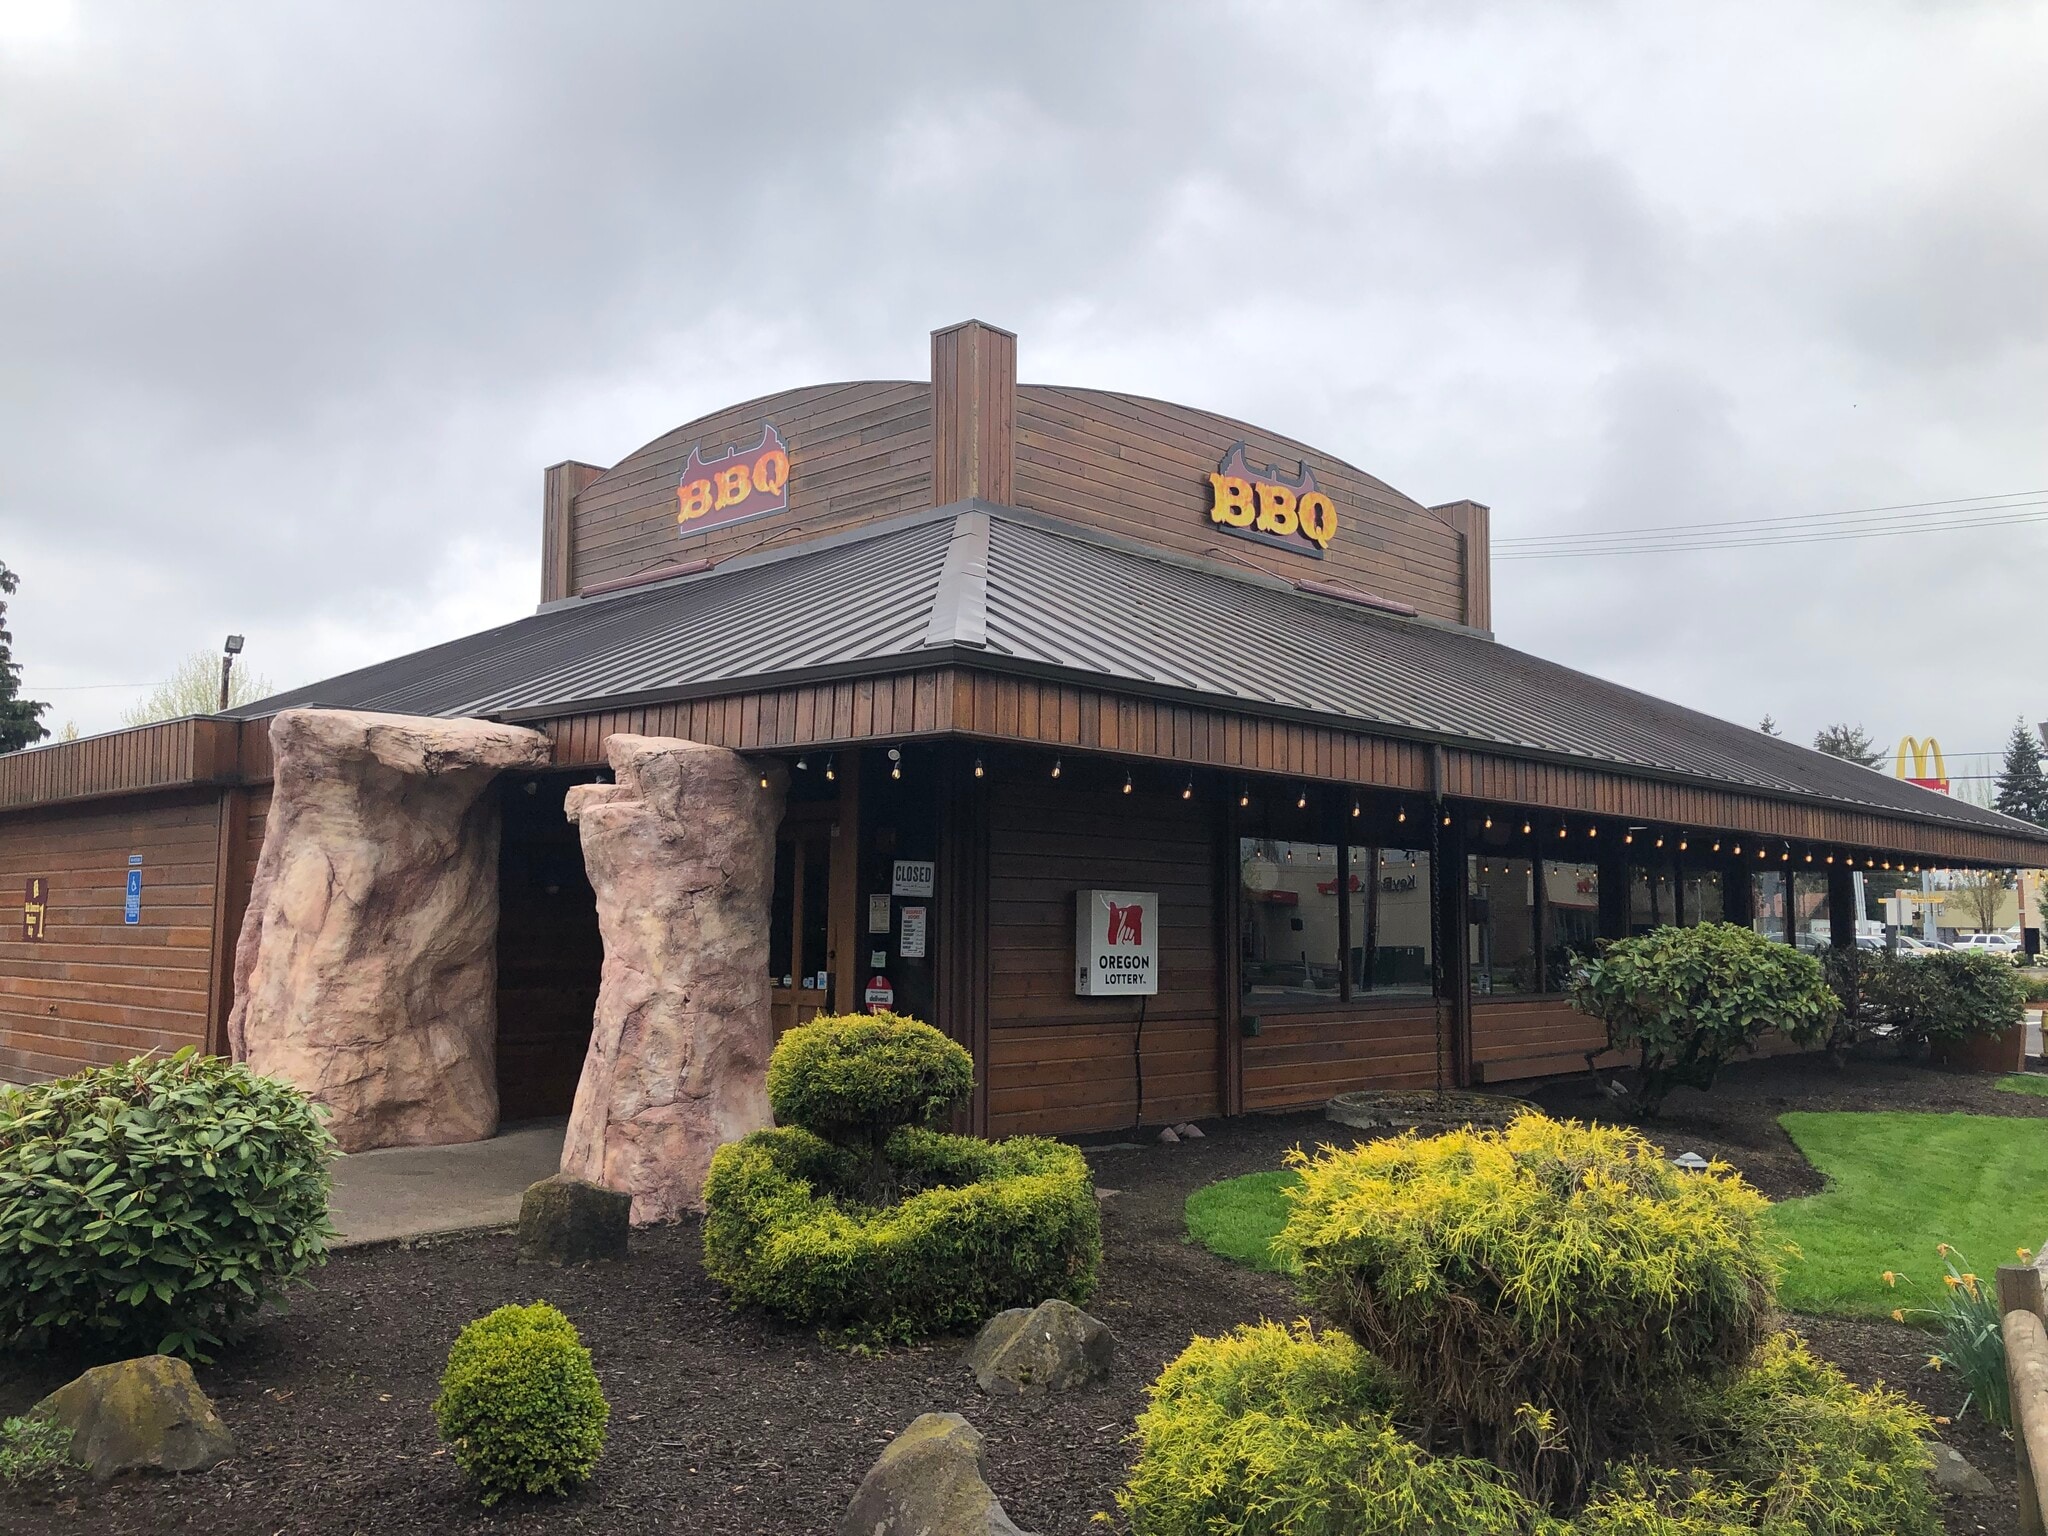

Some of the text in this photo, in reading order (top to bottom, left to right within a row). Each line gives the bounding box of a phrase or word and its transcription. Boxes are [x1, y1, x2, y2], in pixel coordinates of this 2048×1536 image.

[677, 450, 790, 523] BBQ
[1209, 472, 1338, 549] BBQ
[895, 865, 931, 883] CLOSED
[1099, 956, 1149, 969] OREGON
[1105, 974, 1145, 985] LOTTERY
